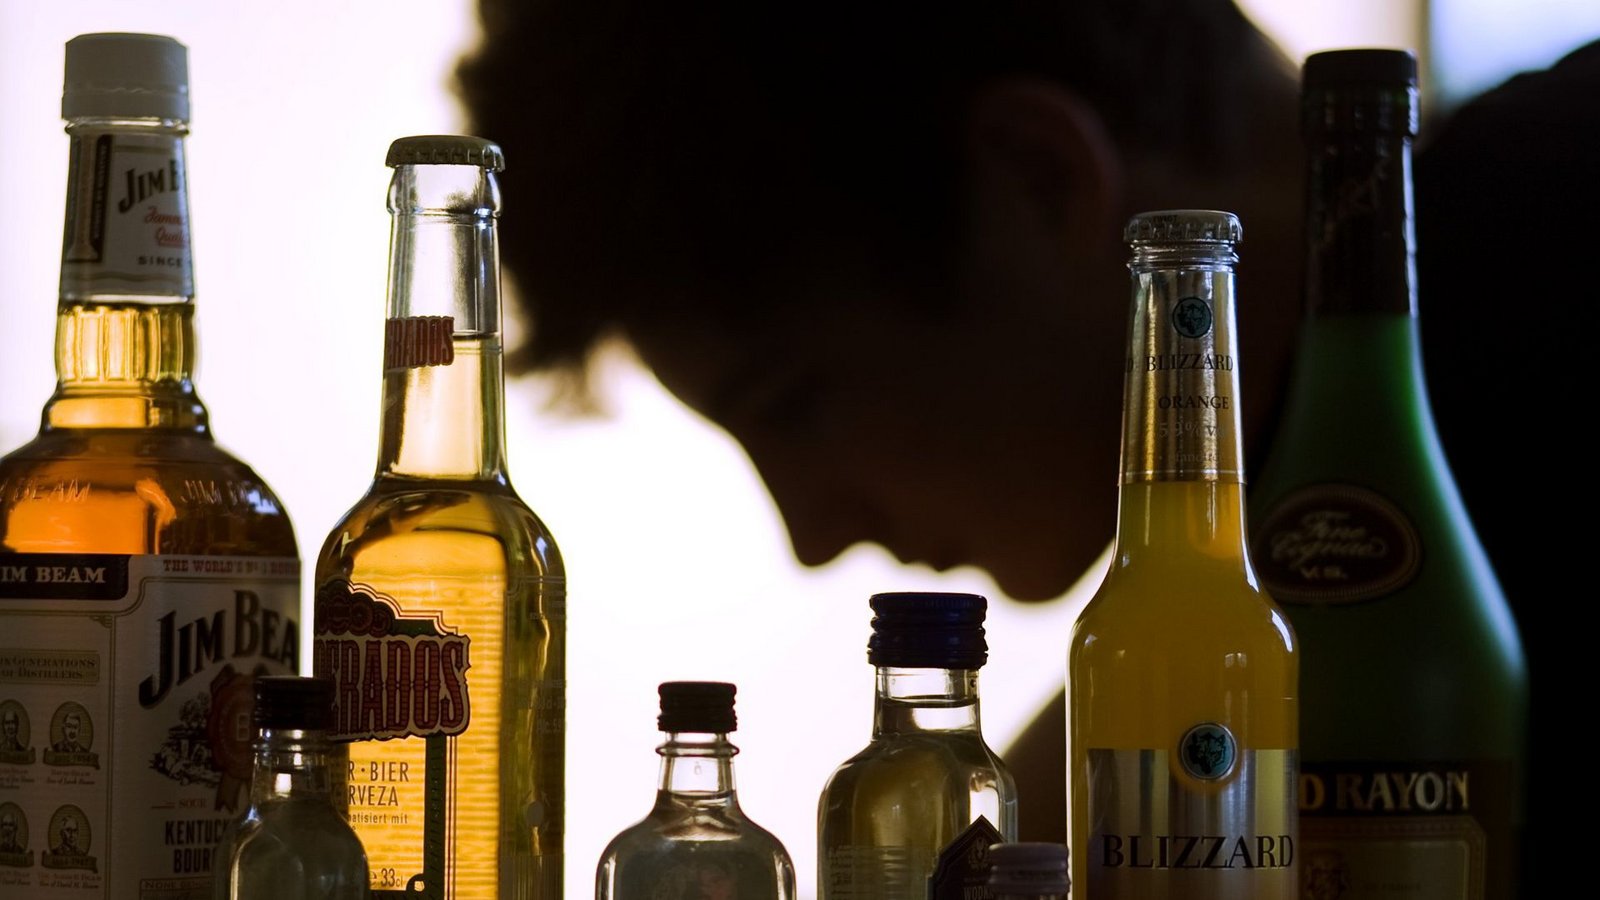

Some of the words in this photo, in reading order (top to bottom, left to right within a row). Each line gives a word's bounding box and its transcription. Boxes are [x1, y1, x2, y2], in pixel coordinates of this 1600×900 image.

[118, 168, 164, 213] JIM
[137, 256, 183, 268] SINCE
[1146, 354, 1233, 372] BLIZZARD
[1158, 396, 1229, 409] ORANGE
[35, 566, 107, 584] BEAM
[162, 559, 189, 573] THE
[138, 609, 227, 710] JIM
[370, 761, 409, 782] BIER
[1336, 771, 1471, 812] RAYON
[391, 813, 408, 824] mit
[1102, 834, 1293, 868] BLIZZARD
